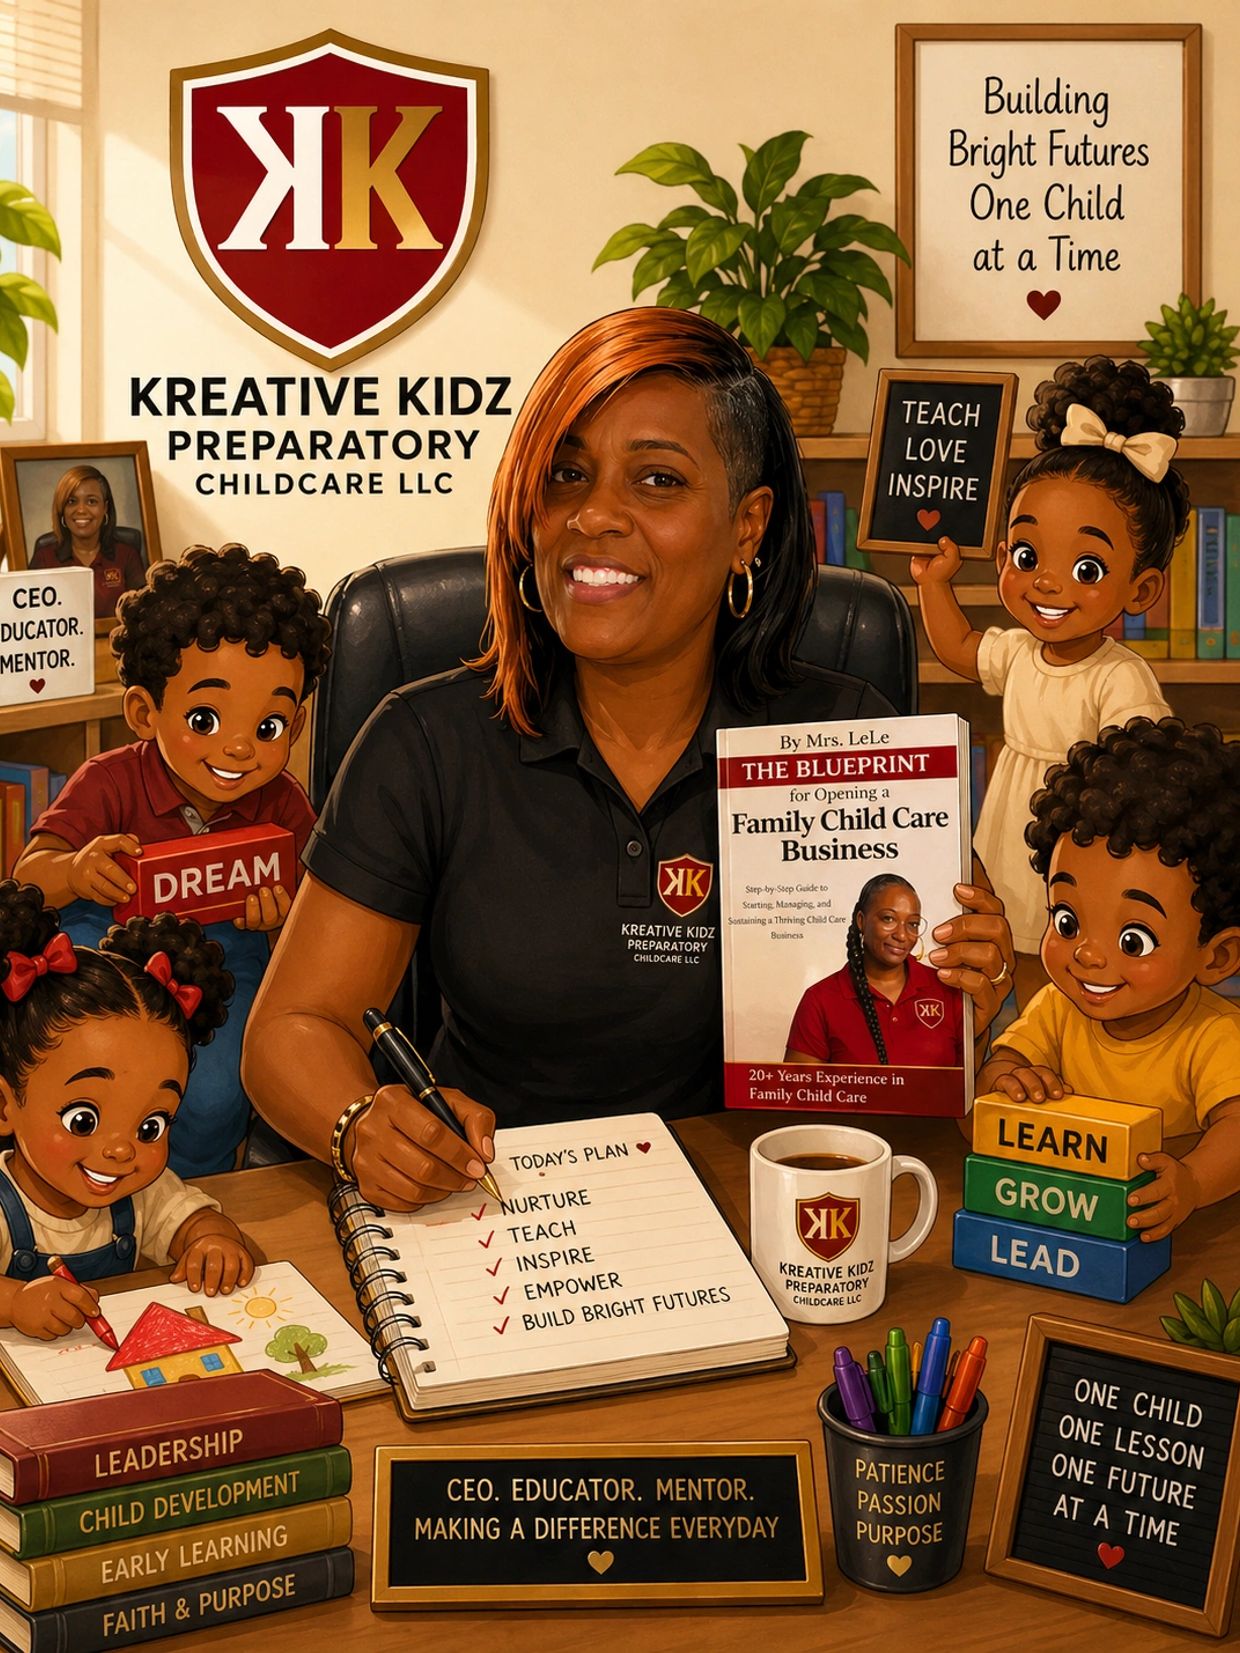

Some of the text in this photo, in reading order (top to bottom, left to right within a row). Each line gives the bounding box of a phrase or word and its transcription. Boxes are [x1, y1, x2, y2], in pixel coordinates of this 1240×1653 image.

[984, 76, 1109, 128] Building
[949, 128, 1149, 180] Bright Futures
[970, 182, 1124, 221] One Child
[973, 235, 1120, 272] at a Time
[131, 376, 512, 416] KREATIVE KIDZ
[902, 400, 980, 428] TEACH
[169, 429, 480, 461] PREPARATORY
[906, 437, 967, 463] LOVE
[196, 472, 453, 495] CHILDCARE LLC
[888, 473, 979, 501] INSPIRE
[13, 587, 62, 609] CEO.
[0, 617, 83, 642] DUCATOR.
[0, 649, 74, 674] MENTOR.
[780, 730, 890, 753] By Mrs. LeLe
[742, 754, 929, 781] THE BLUEPRINT
[790, 787, 890, 804] for Opening a
[732, 807, 949, 837] Family Child Care
[782, 838, 899, 862] Business
[154, 852, 280, 903] DREAM
[746, 885, 794, 895] Step-by-Step
[796, 884, 818, 892] Guide
[621, 924, 715, 938] KREATIVE KIDZ
[774, 916, 805, 926] Thriving
[807, 916, 827, 924] Child
[829, 915, 846, 923] Care
[628, 939, 708, 952] PREPARATORY
[634, 954, 700, 964] CHILDCARE LLC
[749, 1069, 904, 1087] 20+ Years Experience in
[750, 1088, 867, 1103] Family Child Care
[998, 1119, 1107, 1163] LEARN
[509, 1143, 628, 1172] TODAY'S PLAN
[501, 1190, 591, 1216] NURTURE
[995, 1178, 1099, 1221] GROW
[508, 1220, 576, 1243] TEACH
[516, 1247, 594, 1272] INSPIRE
[780, 1260, 874, 1279] KREATIVE KIDZ
[991, 1235, 1080, 1278] LEAD
[524, 1272, 622, 1300] EMPOWER
[786, 1277, 869, 1293] PREPARATORY
[522, 1287, 730, 1331] BUILD BRIGHT FUTURES
[793, 1294, 861, 1306] CHILDCARE LLC
[1075, 1378, 1202, 1428] ONE CHILD
[95, 1429, 243, 1478] LEADERSHIP
[1059, 1414, 1204, 1470] ONE LESSON
[856, 1458, 944, 1484] PATIENCE
[1052, 1453, 1196, 1509] ONE FUTURE
[80, 1471, 300, 1533] CHILD DEVELOPMENT
[447, 1478, 754, 1502] CEO. EDUCATOR. MENTOR.
[858, 1490, 941, 1515] PASSION
[415, 1516, 779, 1541] MAKING A DIFFERENCE EVERYDAY
[857, 1521, 943, 1545] PURPOSE
[1053, 1494, 1180, 1546] AT A TIME
[102, 1525, 288, 1585] EARLY LEARNING
[103, 1574, 296, 1637] FAITH & PURPOSE
